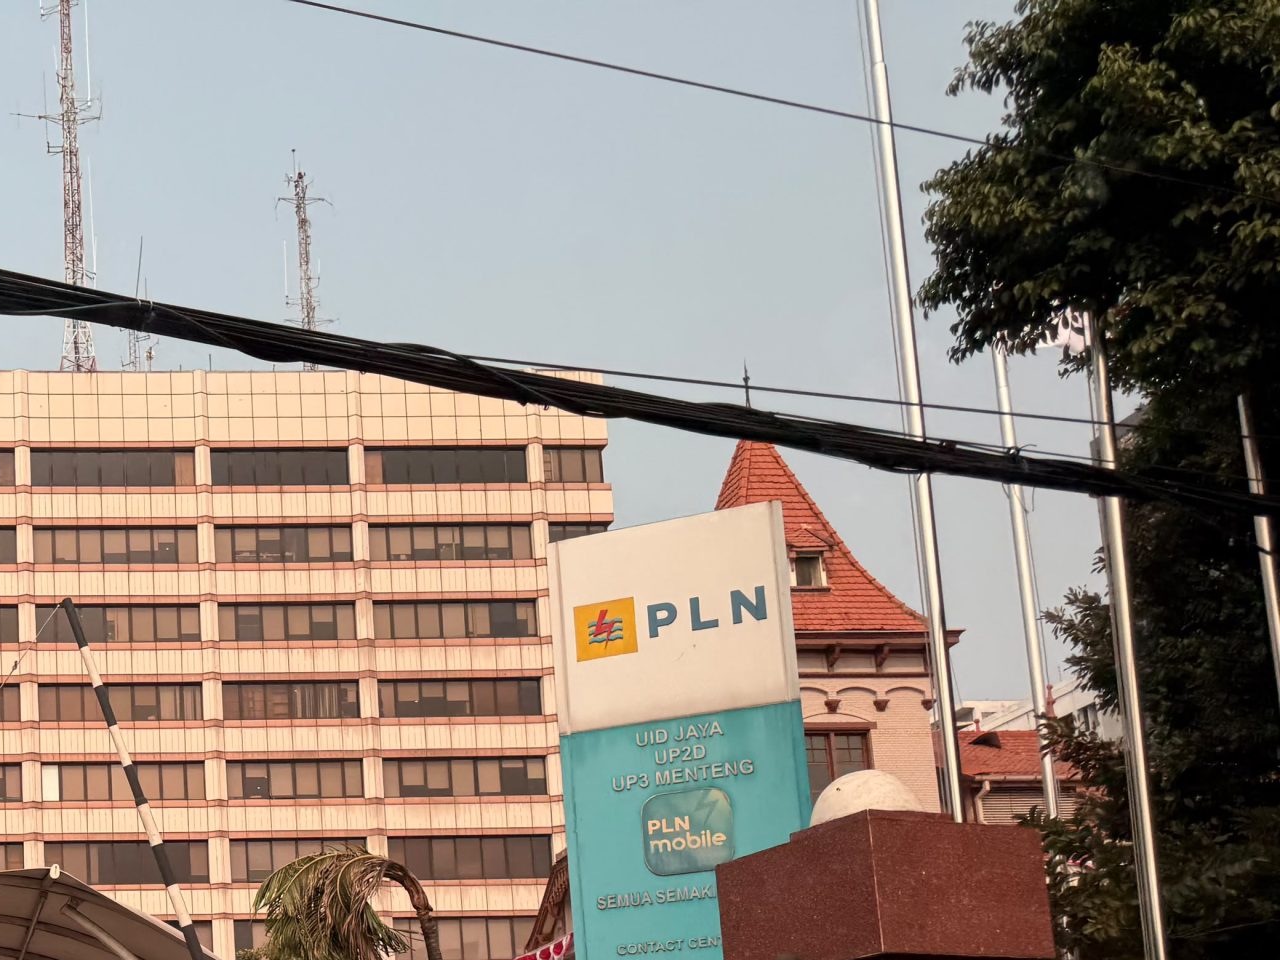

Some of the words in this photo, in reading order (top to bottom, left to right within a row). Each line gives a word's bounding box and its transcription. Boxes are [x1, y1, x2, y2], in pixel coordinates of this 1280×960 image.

[647, 585, 768, 638] PLN
[635, 728, 668, 747] UID
[673, 720, 724, 742] JAYA
[654, 744, 707, 765] UP2D
[612, 773, 649, 792] UP3
[655, 759, 754, 786] MENTENG
[647, 815, 690, 835] PLN
[649, 829, 727, 854] mobile
[597, 891, 653, 910] SEMUA
[617, 939, 684, 956] CONTACT
